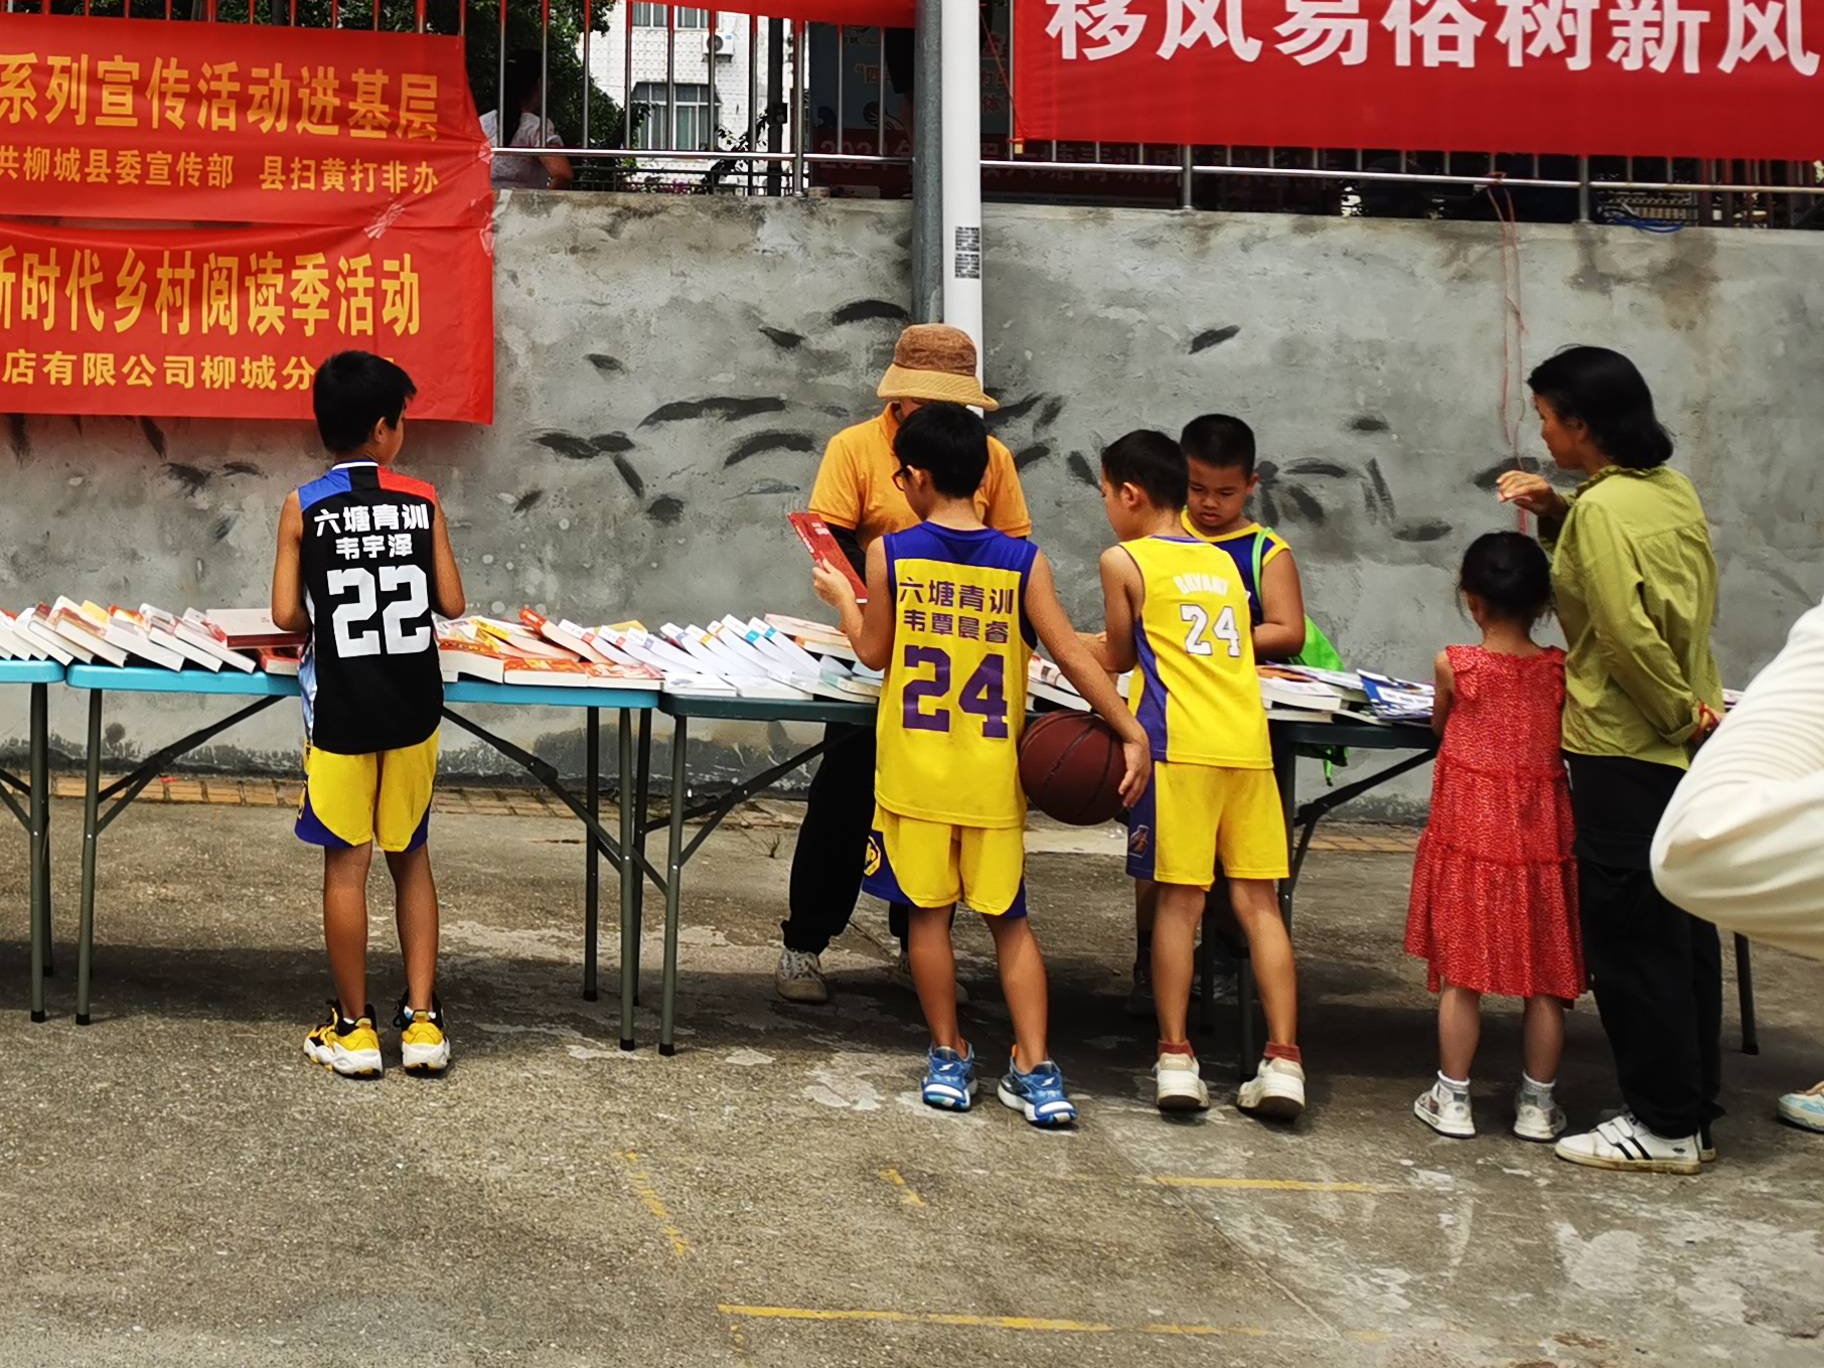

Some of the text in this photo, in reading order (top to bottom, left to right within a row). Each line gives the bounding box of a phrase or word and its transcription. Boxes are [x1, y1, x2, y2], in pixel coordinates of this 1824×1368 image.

[314, 503, 430, 537] 六塘青训
[327, 564, 431, 658] 22
[899, 576, 1014, 615] 六塘青训
[1179, 604, 1240, 657] 24
[903, 644, 1008, 739] 24
